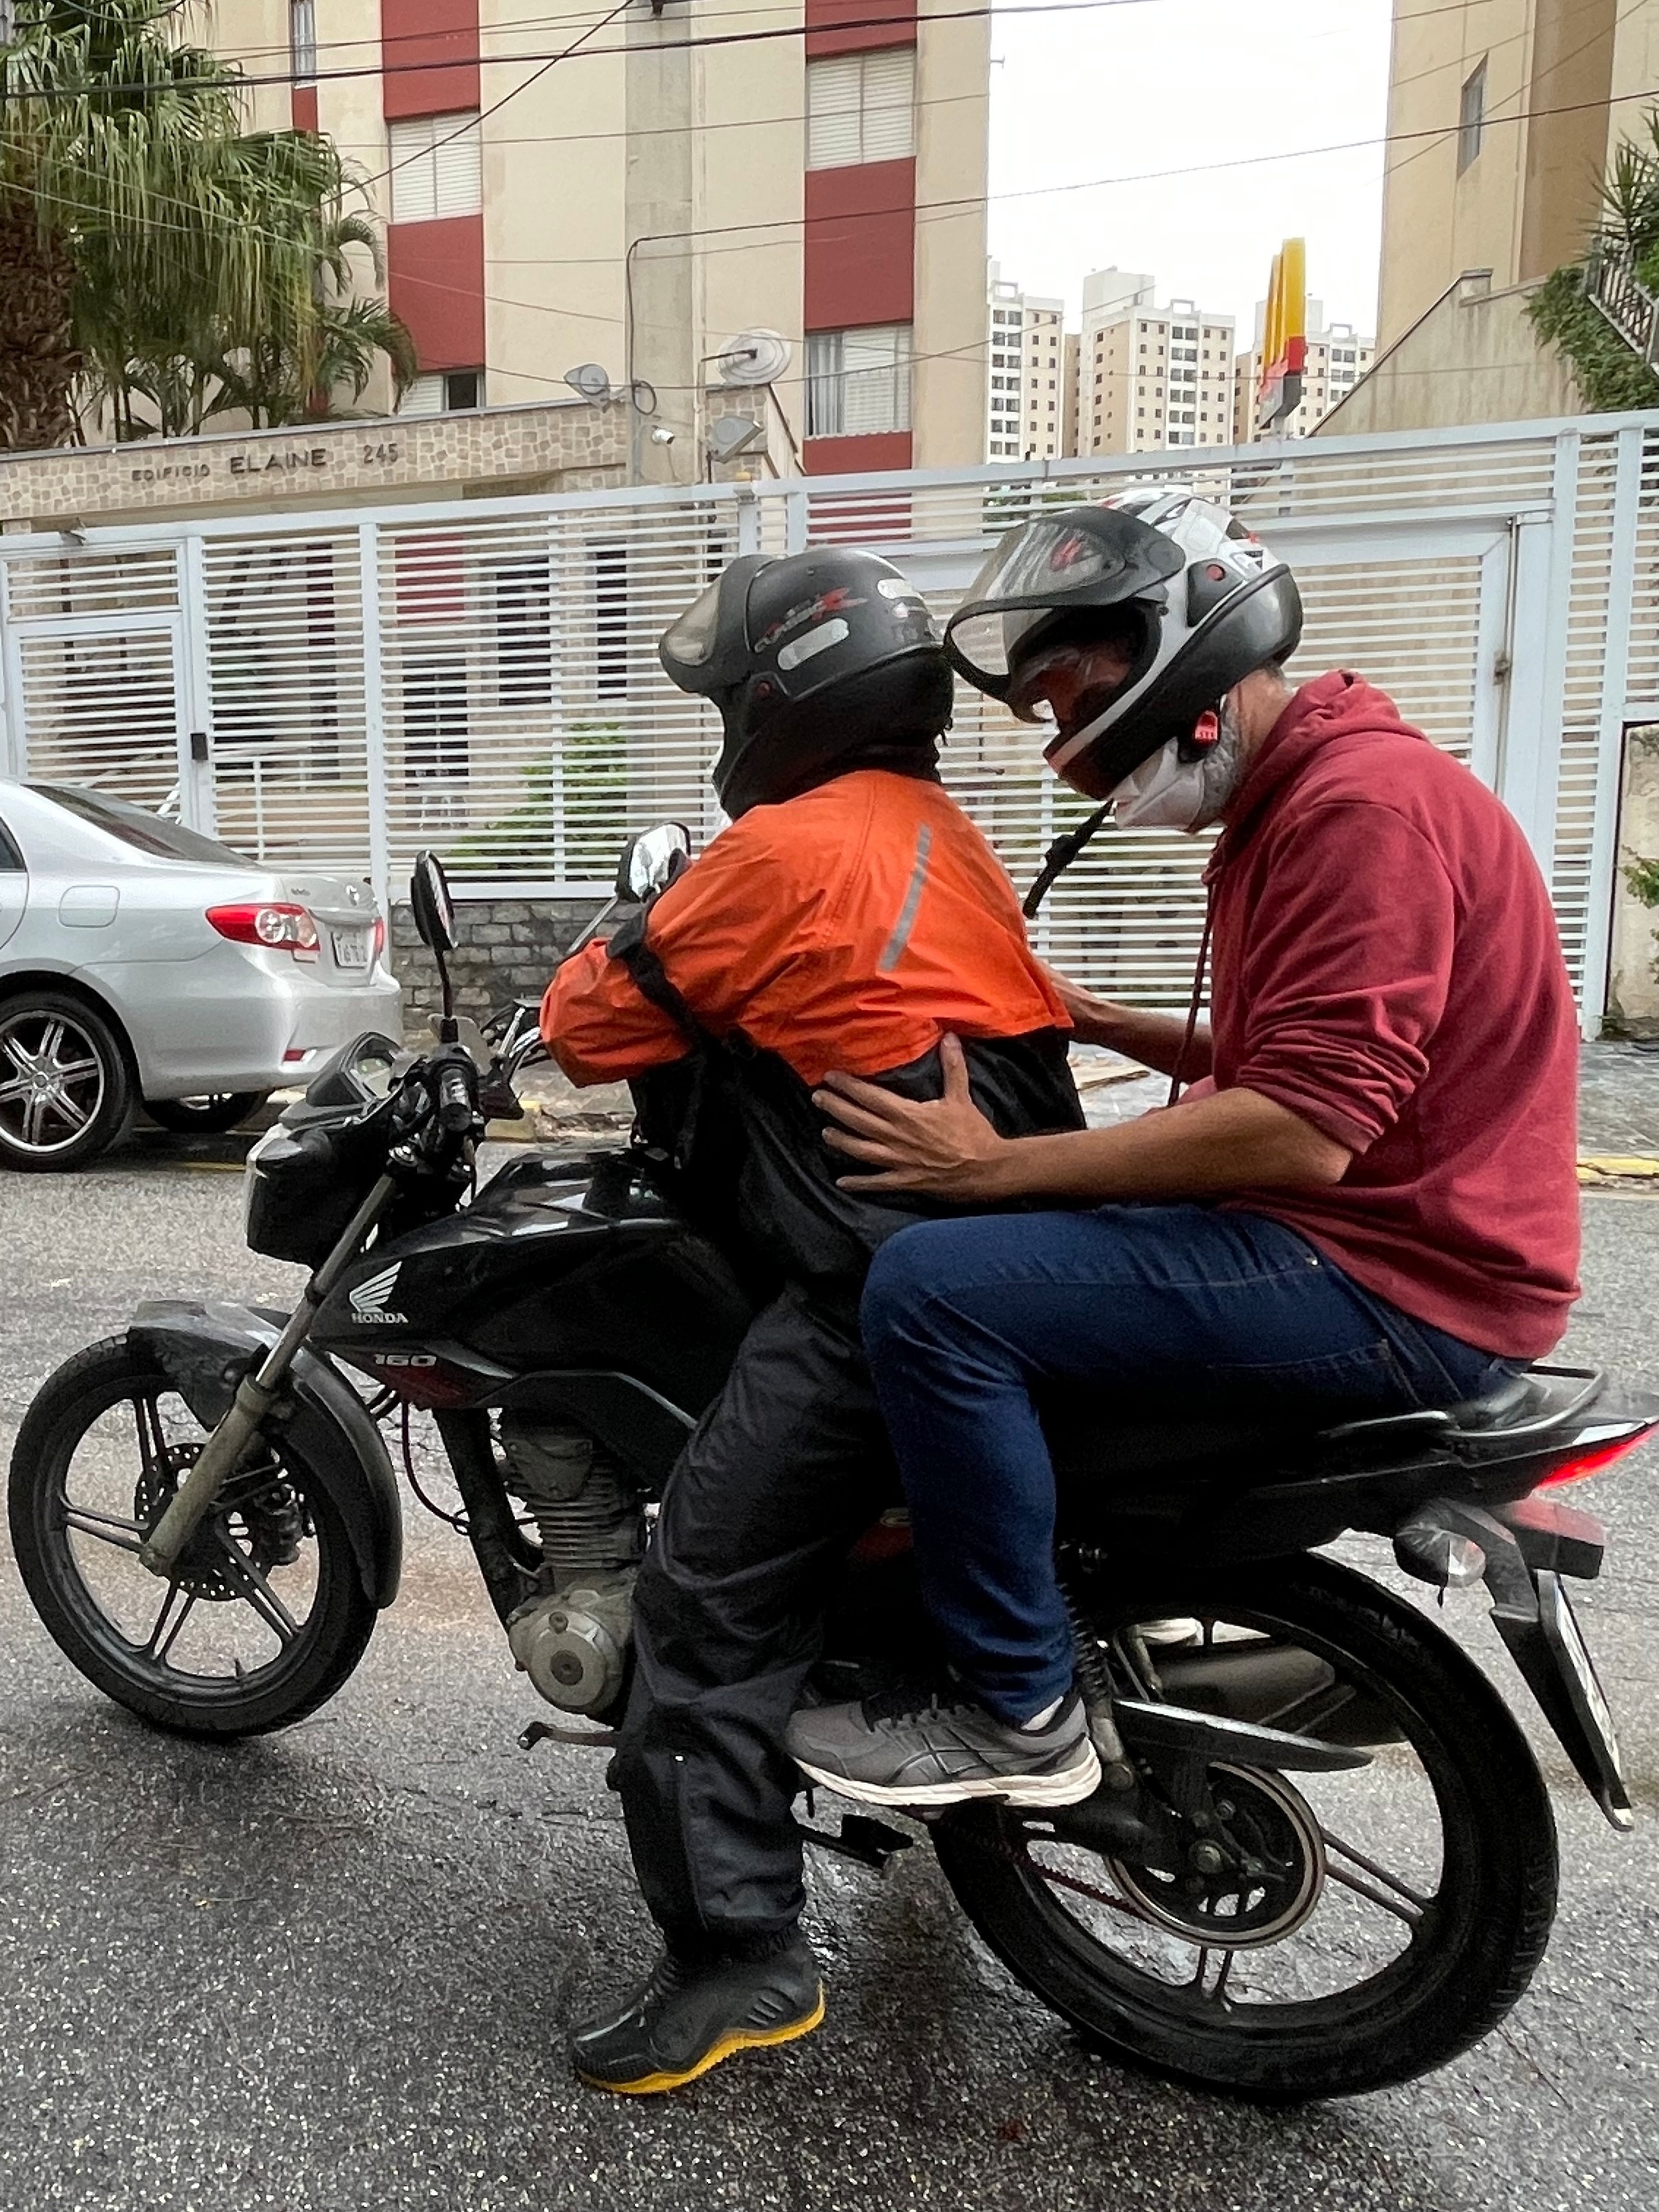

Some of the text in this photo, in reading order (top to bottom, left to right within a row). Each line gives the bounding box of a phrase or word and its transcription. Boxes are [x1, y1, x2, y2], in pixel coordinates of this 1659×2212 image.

[132, 443, 399, 482] EDIFICIO ELAINE 245
[351, 1312, 409, 1324] HONDA
[375, 1353, 437, 1366] 160
